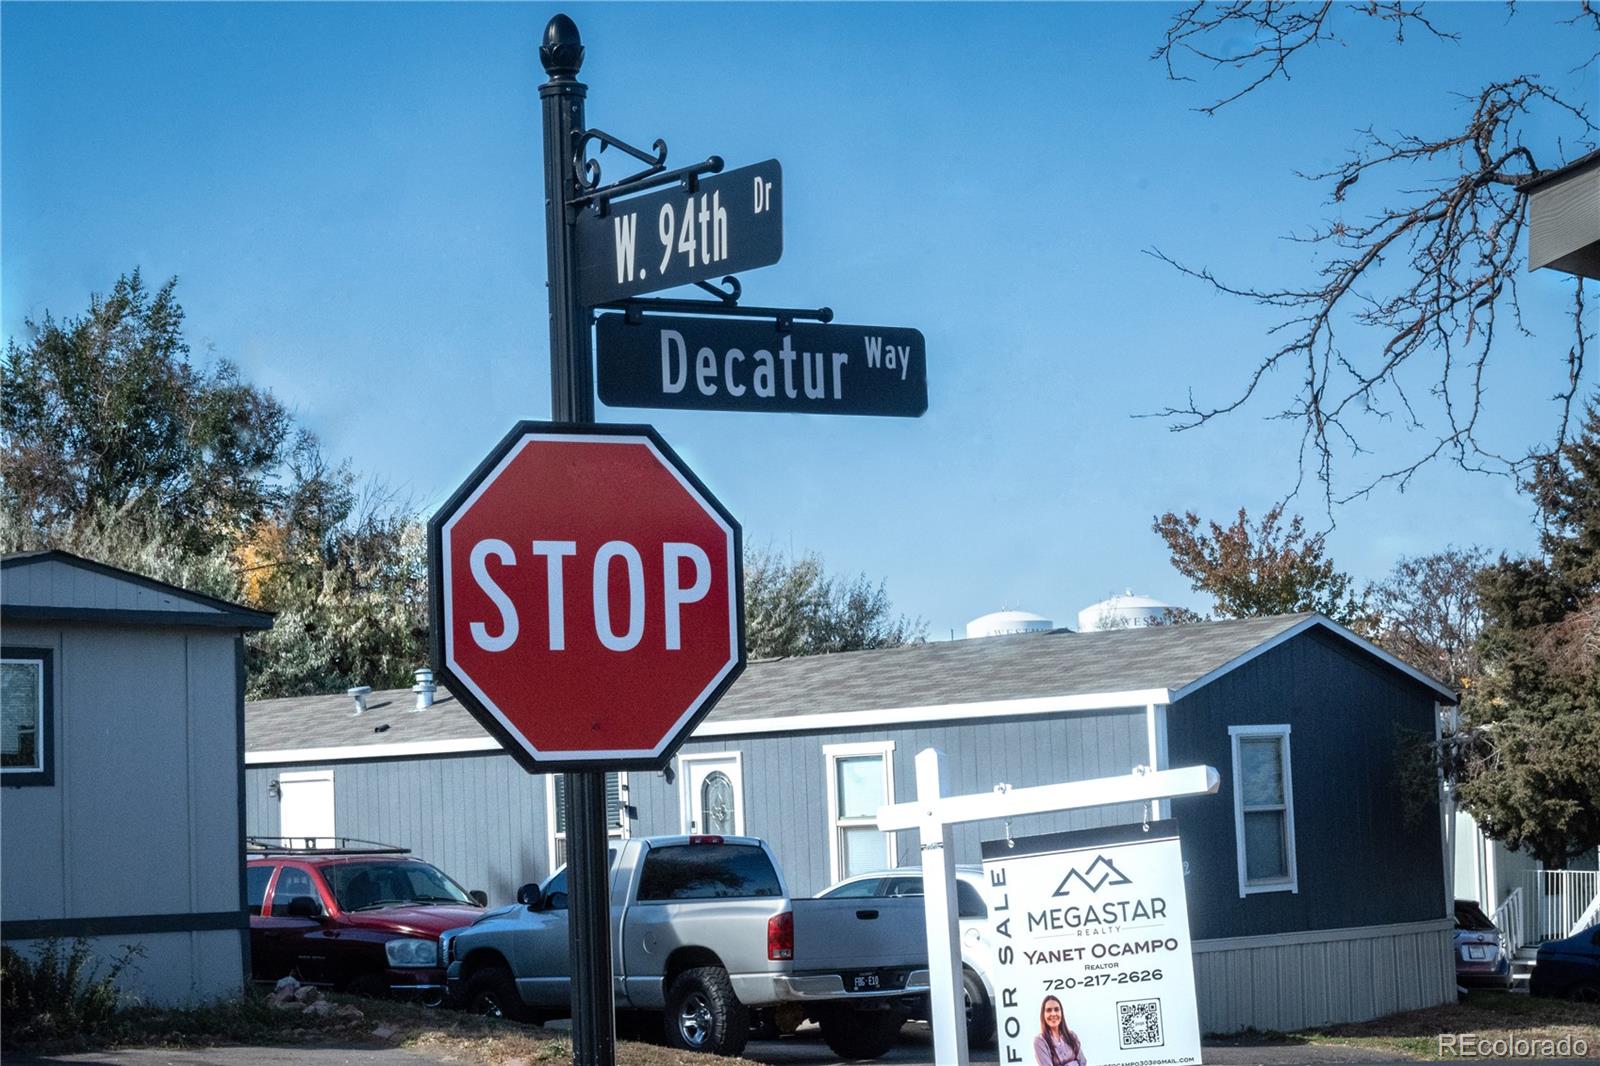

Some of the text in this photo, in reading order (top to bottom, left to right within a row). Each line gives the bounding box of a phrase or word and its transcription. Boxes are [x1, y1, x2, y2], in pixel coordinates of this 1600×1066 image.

[614, 176, 772, 284] W. 94th Dr
[660, 329, 910, 400] Decatur Way
[469, 538, 712, 652] STOP
[1027, 897, 1167, 932] MEGASTAR
[1076, 925, 1121, 937] REALTY
[990, 867, 1023, 1063] FOR SALE
[1023, 938, 1178, 965] YANET OCAMPO
[1084, 962, 1119, 972] REALTOR
[1043, 968, 1164, 992] 720-217-2626
